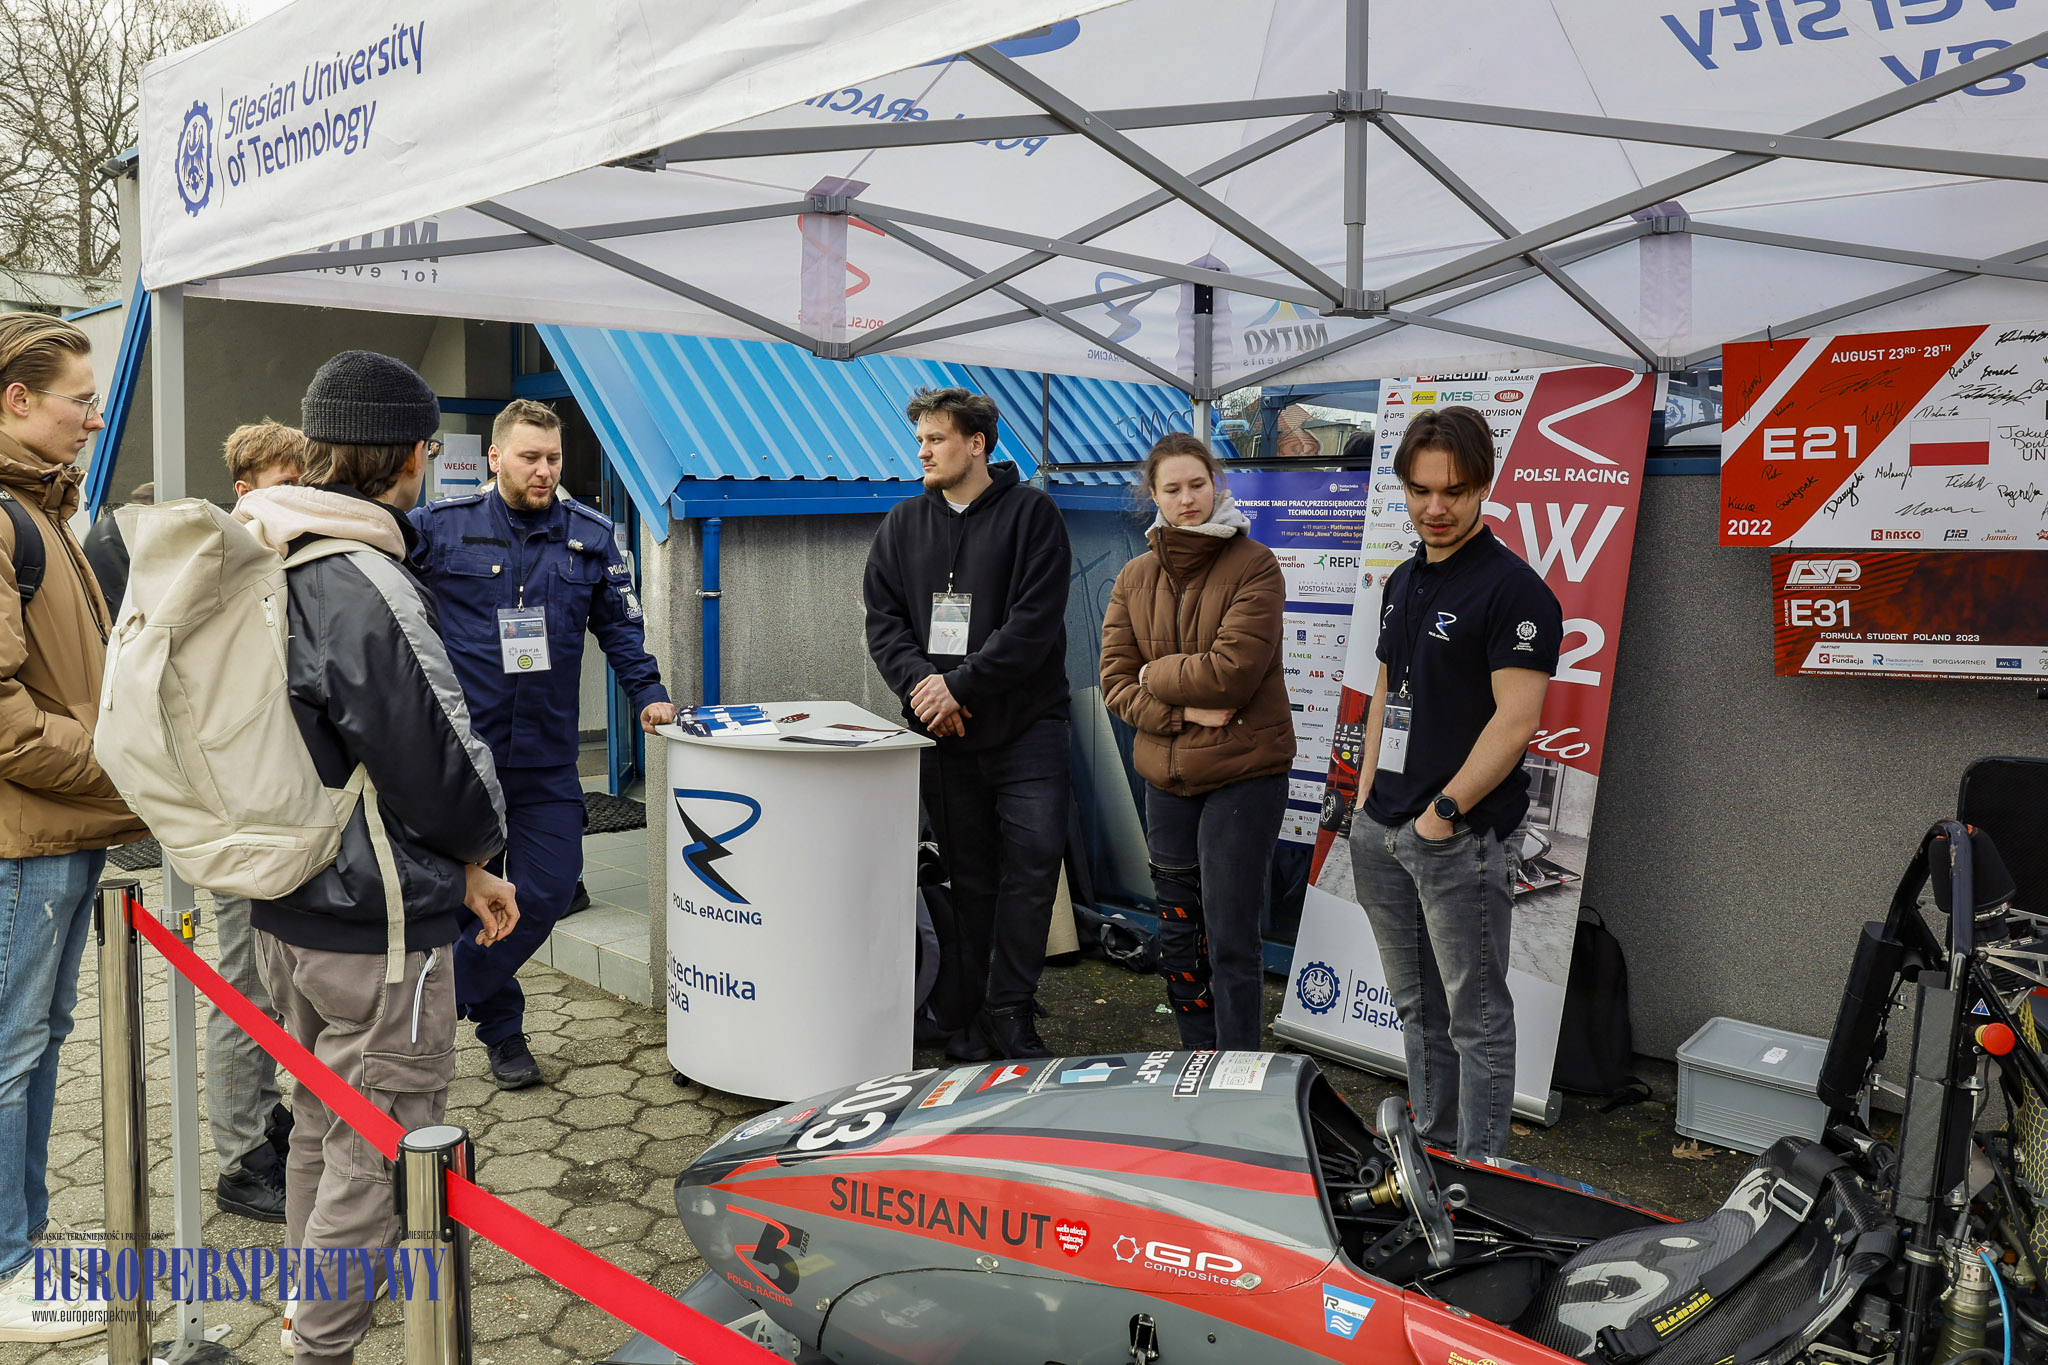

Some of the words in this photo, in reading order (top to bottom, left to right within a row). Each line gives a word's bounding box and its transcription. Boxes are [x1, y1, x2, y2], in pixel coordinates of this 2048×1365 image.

[225, 81, 296, 140] Silesian
[302, 20, 425, 106] University
[227, 139, 247, 188] of
[247, 100, 377, 176] Technology
[1831, 349, 1885, 364] AUGUST
[1480, 408, 1522, 417] ADVISION
[1491, 429, 1512, 437] KF
[1763, 425, 1857, 461] E21
[444, 461, 478, 471] WEJŚCIE
[1514, 468, 1562, 482] POLSL
[1564, 468, 1630, 485] RACING
[1234, 498, 1270, 507] NŻYNIERSKIE
[1387, 502, 1408, 512] FES
[1332, 509, 1366, 518] DOSTĘPNO
[1727, 519, 1772, 536] 2022
[1885, 530, 1922, 540] RASCO
[1981, 533, 2018, 541] Jamnica
[1329, 556, 1361, 568] REPL
[1298, 585, 1336, 593] MOSTOSTAL
[1336, 586, 1357, 594] ZABRZ
[1790, 599, 1851, 627] E31
[1820, 632, 1862, 640] FORMULA
[1866, 632, 1908, 641] STUDENT
[1913, 633, 1951, 641] POLAND
[1955, 634, 1980, 642] 2023
[1832, 657, 1864, 665] Fundacja
[1309, 670, 1325, 679] ABB
[673, 892, 698, 916] POLSL
[699, 905, 763, 926] eRACING
[1355, 980, 1394, 1008] Poli
[829, 1176, 988, 1241] SILESIAN
[1001, 1209, 1051, 1249] UT
[799, 1230, 811, 1259] YEARS
[1145, 1240, 1243, 1273] GP
[1143, 1261, 1239, 1288] composites
[726, 1271, 756, 1293] POLSL
[756, 1284, 793, 1307] RACING
